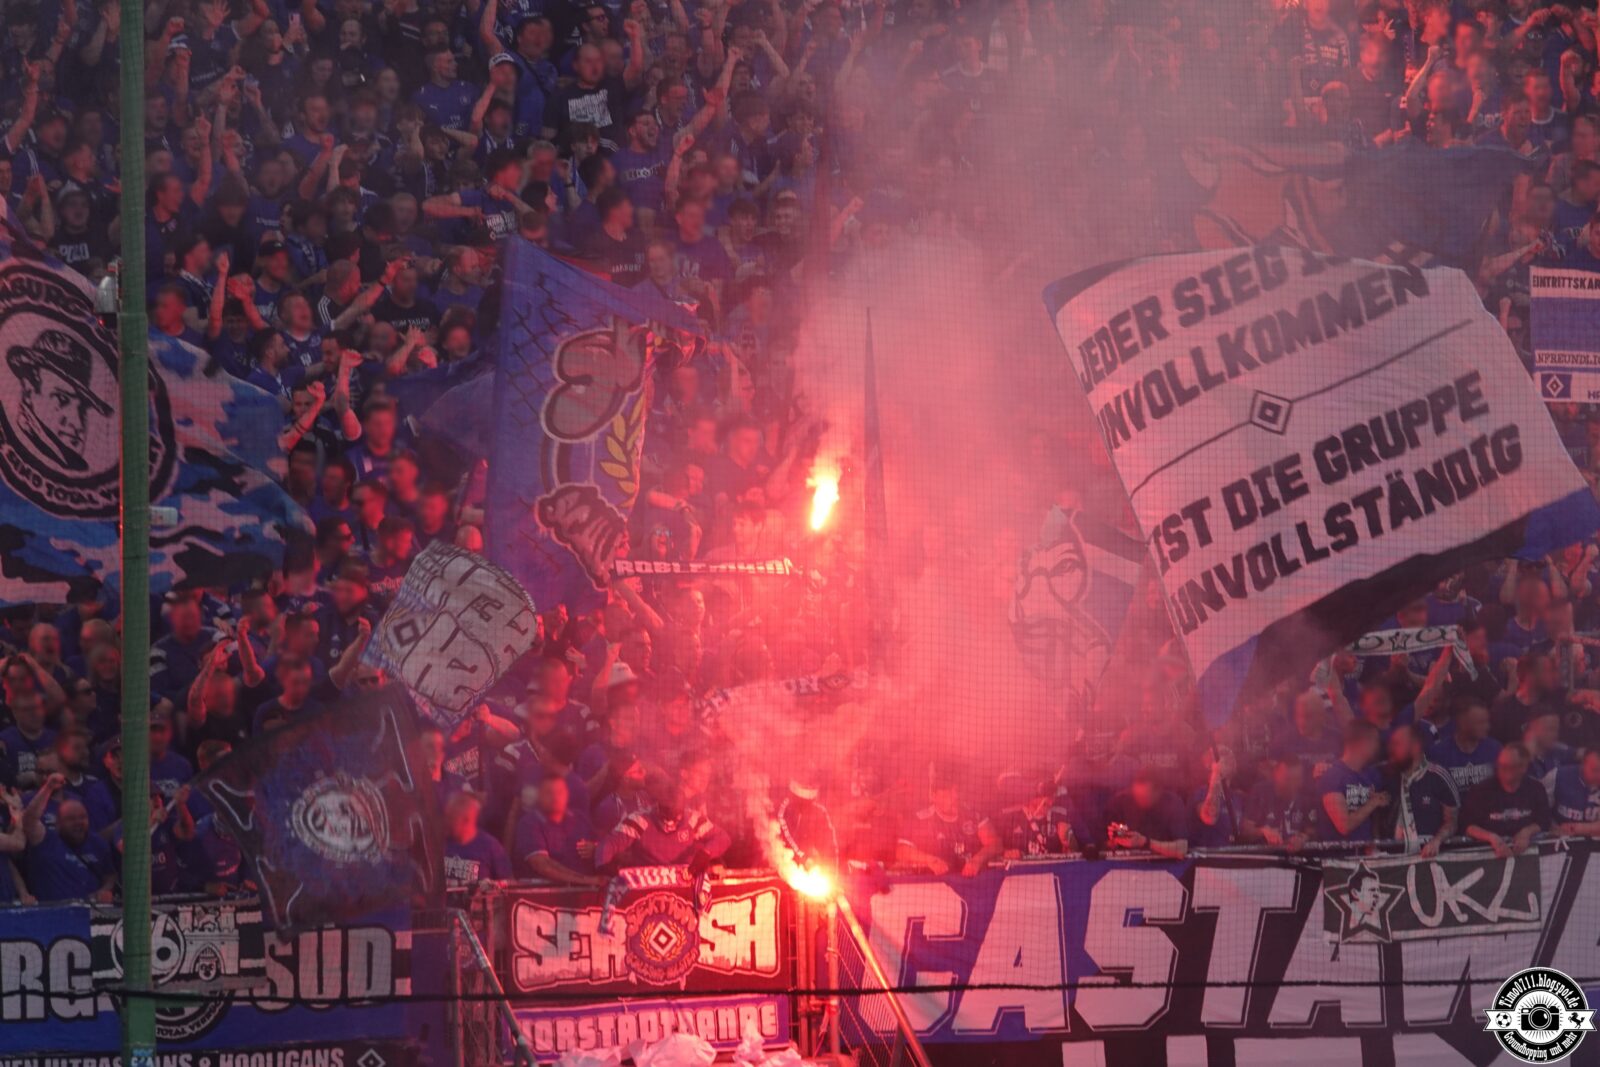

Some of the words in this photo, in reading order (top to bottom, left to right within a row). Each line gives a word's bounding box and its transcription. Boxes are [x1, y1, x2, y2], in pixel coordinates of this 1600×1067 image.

[1077, 295, 1171, 395] JEDER
[1172, 243, 1290, 328] SIEG
[1147, 496, 1214, 578] IST
[1220, 452, 1310, 533] DIE
[1311, 369, 1490, 484] GRUPPE
[1168, 422, 1524, 637] UNVOLLSTÄNDIG
